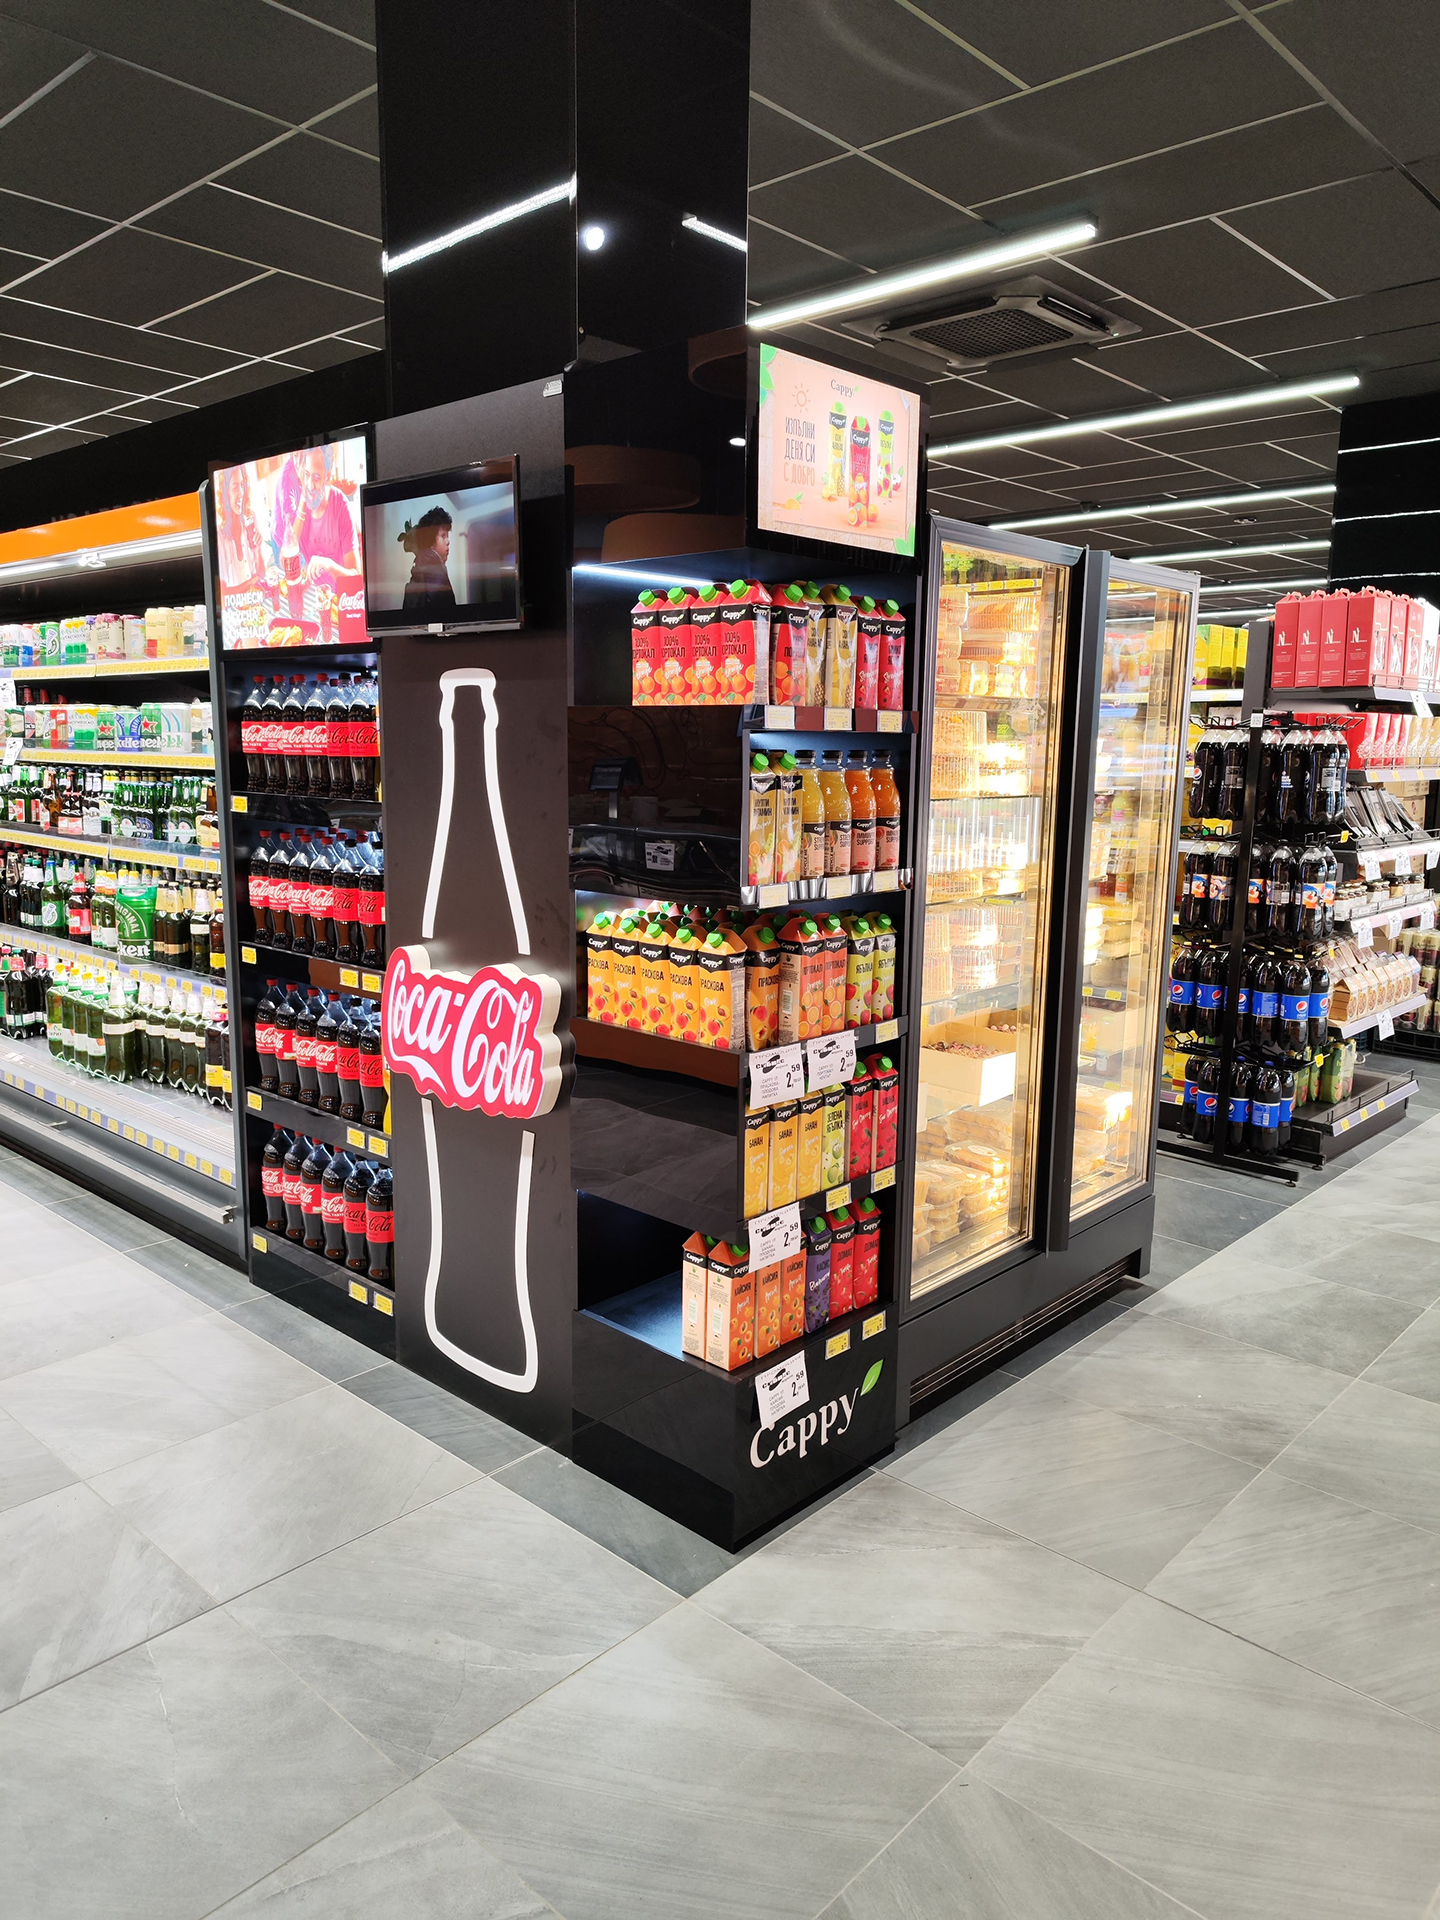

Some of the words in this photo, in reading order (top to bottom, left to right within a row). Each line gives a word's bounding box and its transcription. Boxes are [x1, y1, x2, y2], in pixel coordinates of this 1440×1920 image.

[831, 380, 853, 397] Cappy
[785, 416, 816, 440] ИЗПЪЛНИ
[784, 438, 803, 461] ДЕНЯ
[804, 443, 816, 463] СИ
[791, 465, 816, 487] ДОБРО
[224, 590, 263, 608] ПОДНЕСИ
[662, 614, 680, 625] Cappy
[692, 612, 712, 623] Cappy
[722, 610, 743, 620] Cappy
[788, 613, 805, 624] Cappy
[633, 616, 650, 626] Cappy
[862, 622, 878, 633] Cappy
[885, 625, 902, 635] Cappy
[588, 938, 605, 948] Cappy
[614, 942, 631, 953] Cappy
[826, 940, 843, 949] Cappy
[641, 948, 659, 958] Cappy
[803, 945, 818, 953] Cappy
[670, 952, 688, 963] Cappy
[701, 957, 719, 968] Cappy
[845, 1049, 853, 1058] 59
[791, 1063, 801, 1073] 59
[854, 1085, 867, 1093] Cappy
[881, 1080, 893, 1088] Cappy
[826, 1095, 840, 1103] Cappy
[803, 1102, 818, 1110] Cappy
[777, 1110, 792, 1118] Cappy
[827, 1109, 843, 1123] ЗЕЛЕНА
[747, 1118, 762, 1126] Cappy
[804, 1120, 818, 1132] БАНАН
[826, 1120, 843, 1133] ЯБЪЛКА
[778, 1128, 793, 1141] БАНАН
[749, 1136, 764, 1149] БАНАН
[789, 1222, 799, 1232] 59
[863, 1223, 878, 1231] Cappy
[836, 1231, 852, 1240] Cappy
[815, 1243, 830, 1252] Cappy
[686, 1253, 700, 1264] Cappy
[711, 1262, 727, 1273] Cappy
[786, 1260, 804, 1273] КАЙСИЯ
[762, 1271, 779, 1285] КАЙСИЯ
[734, 1282, 752, 1296] КАЙСИЯ
[795, 1370, 805, 1381] 59
[750, 1387, 859, 1469] Cappy
